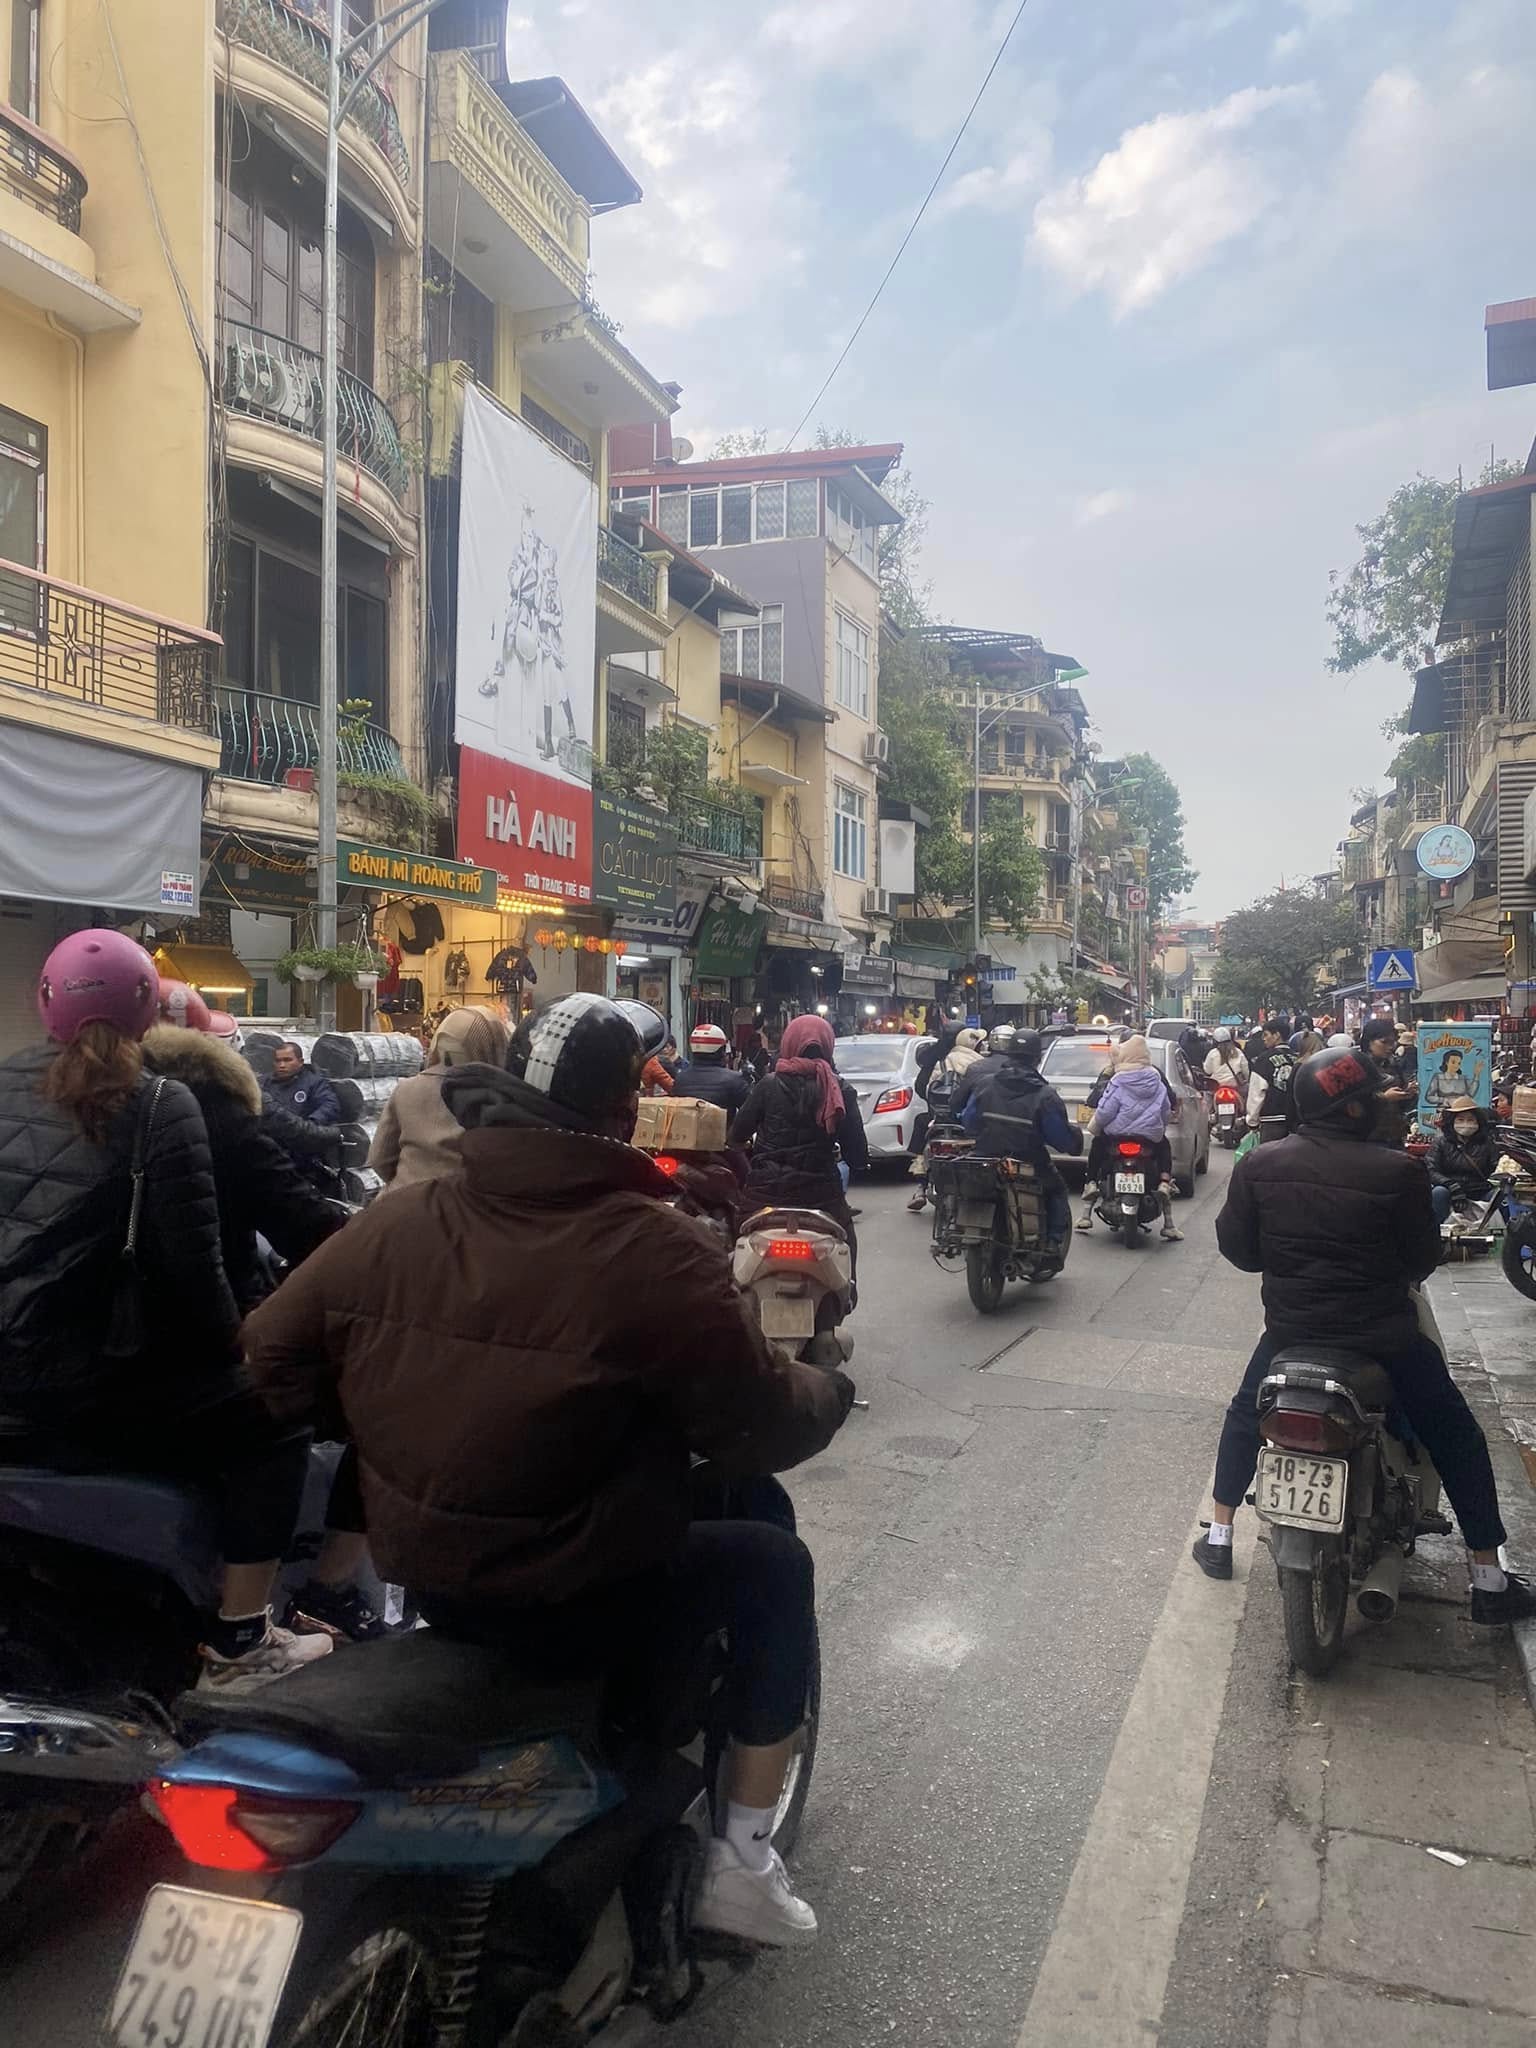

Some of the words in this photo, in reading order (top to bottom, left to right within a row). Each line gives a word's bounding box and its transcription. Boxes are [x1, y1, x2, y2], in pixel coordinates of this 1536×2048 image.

[486, 790, 523, 846] HÀ
[527, 809, 577, 860] ANH
[348, 850, 389, 879] BÁNH
[391, 857, 409, 882] MÌ
[411, 862, 455, 889] HOÀNG
[456, 870, 483, 893] PHỐ
[600, 837, 637, 880] CÁT
[640, 856, 673, 894] LỢI
[524, 870, 540, 890] THỜI
[540, 876, 563, 895] TRANG
[563, 880, 577, 897] TRẺ
[578, 885, 591, 900] EM
[1274, 1457, 1334, 1488] 18-Z3
[1270, 1484, 1331, 1516] 5126
